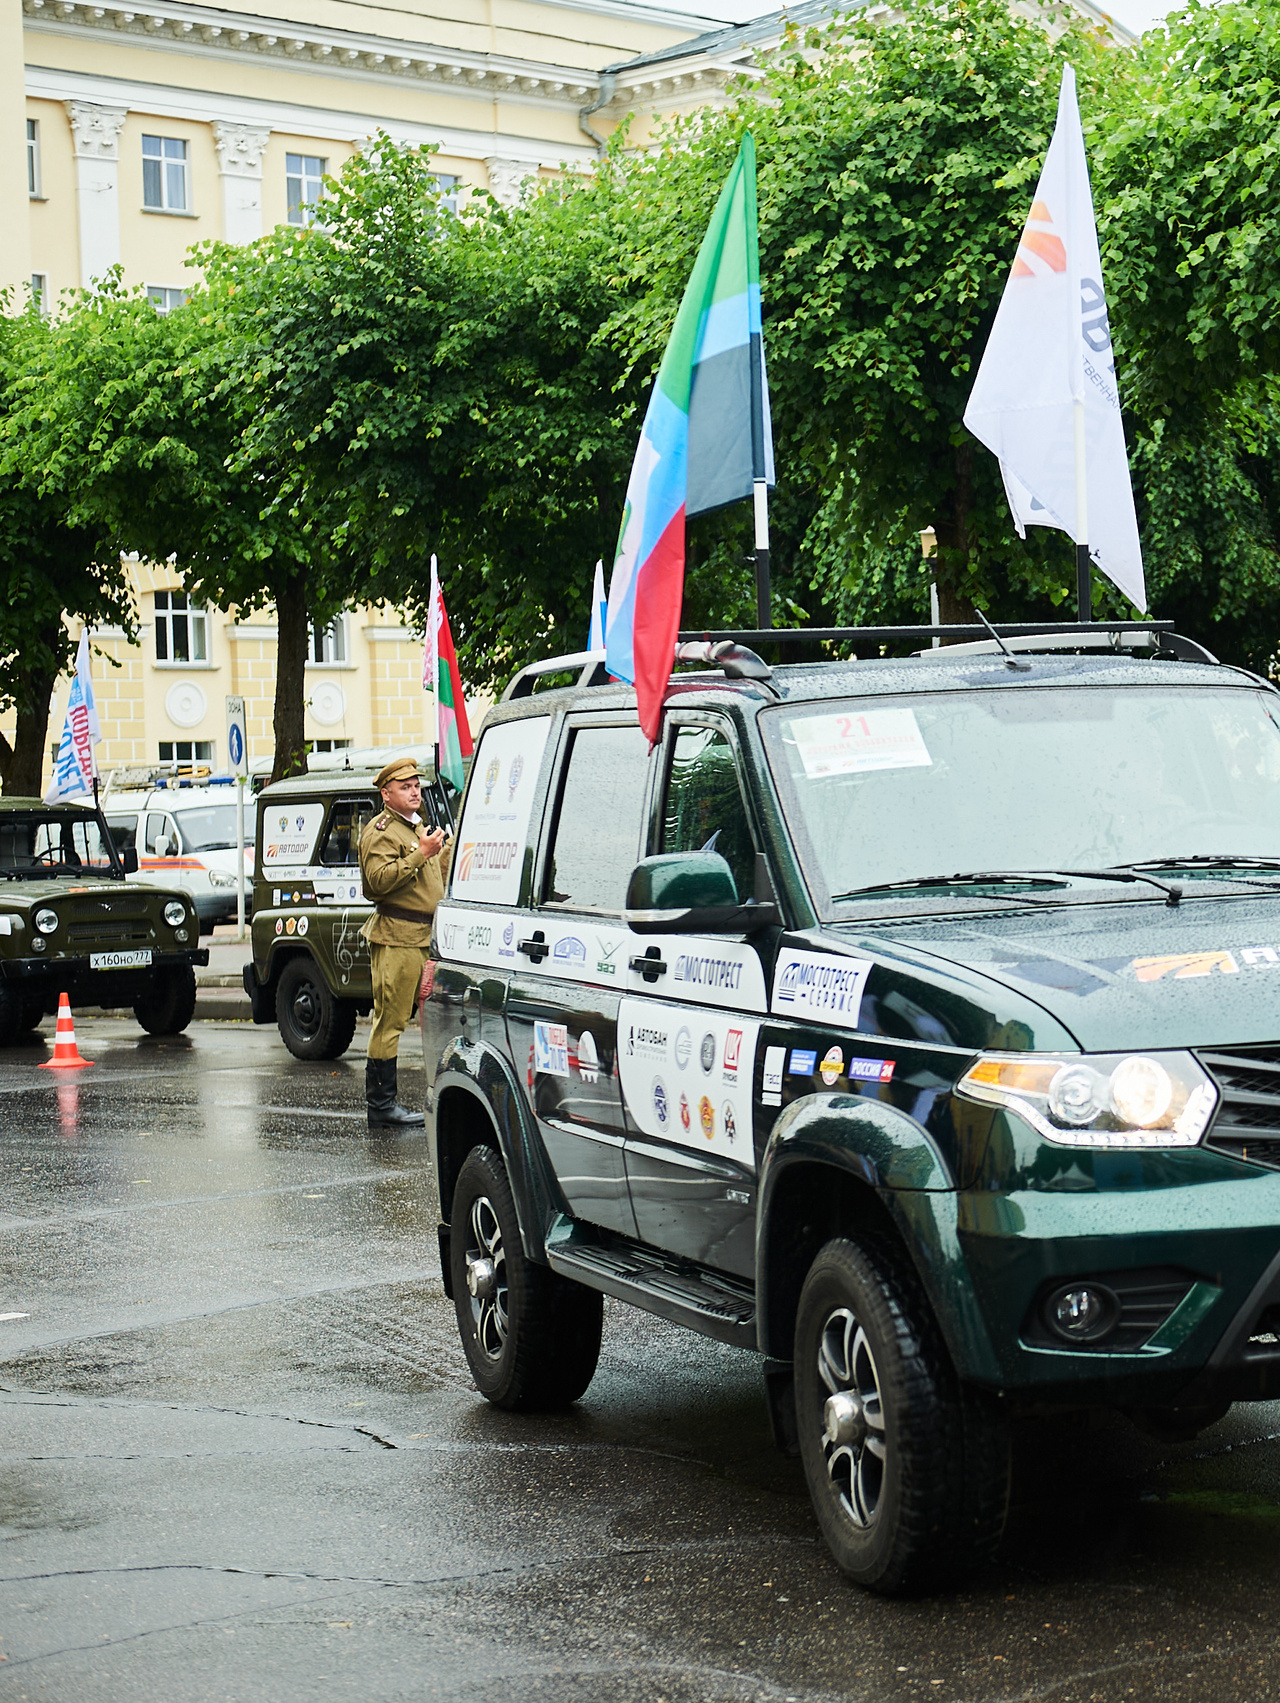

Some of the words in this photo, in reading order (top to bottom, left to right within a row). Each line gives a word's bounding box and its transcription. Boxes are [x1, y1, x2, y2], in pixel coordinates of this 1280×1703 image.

[836, 716, 871, 738] 21
[57, 751, 87, 796] ЛЕТ
[278, 843, 309, 854] АВТОДОР
[472, 842, 518, 870] АВТОДОР
[93, 954, 133, 967] Х160НО
[134, 951, 149, 961] 777
[683, 955, 743, 990] МОСТОТРЕСТ
[798, 962, 860, 994] МОСТОТРЕСТ
[636, 1026, 669, 1047] АВТОБАН
[850, 1061, 881, 1077] РОССИЯ
[880, 1064, 895, 1078] 24
